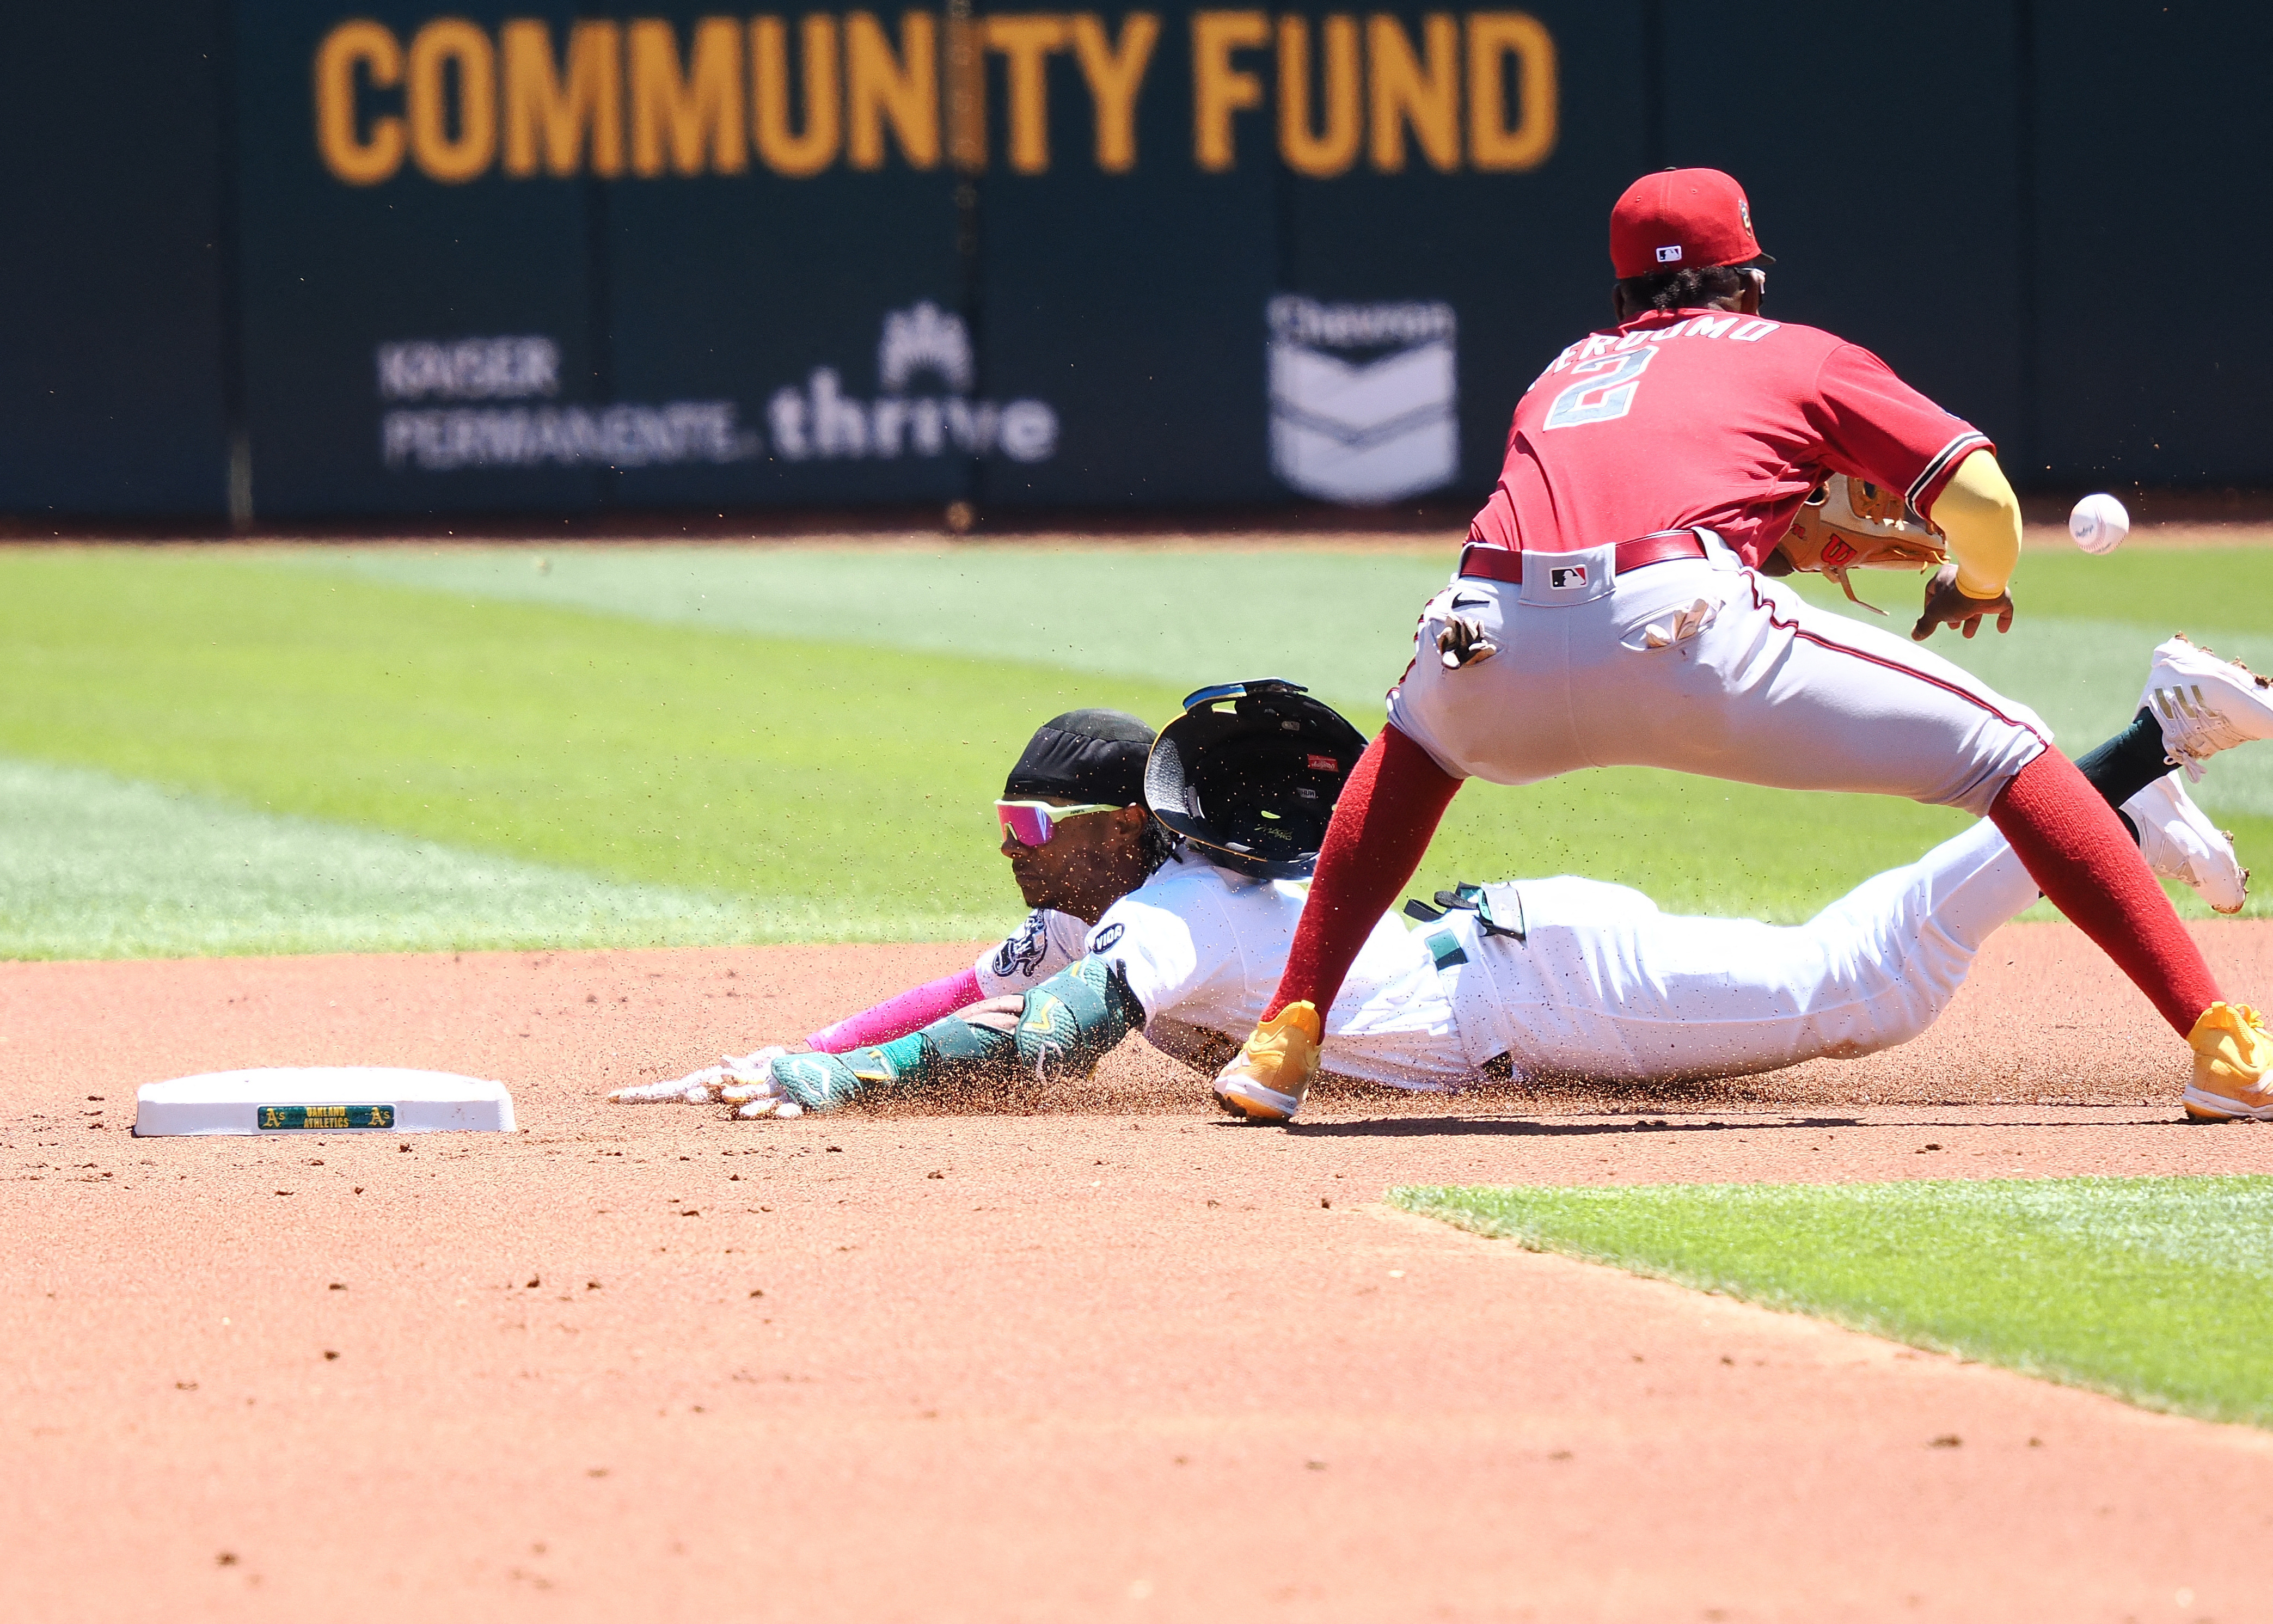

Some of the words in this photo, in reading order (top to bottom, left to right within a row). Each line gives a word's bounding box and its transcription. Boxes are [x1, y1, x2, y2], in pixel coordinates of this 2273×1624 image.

[316, 11, 1160, 184] COMMUNITY
[1192, 10, 1558, 176] FUND
[1267, 297, 1456, 345] Chevron
[378, 336, 558, 397] KAISER
[1543, 345, 1660, 432] 2
[769, 368, 1058, 461] thrive
[1095, 924, 1123, 951] VIDA
[303, 1117, 350, 1128] ATHLETICS
[306, 1106, 346, 1117] OAKLAND
